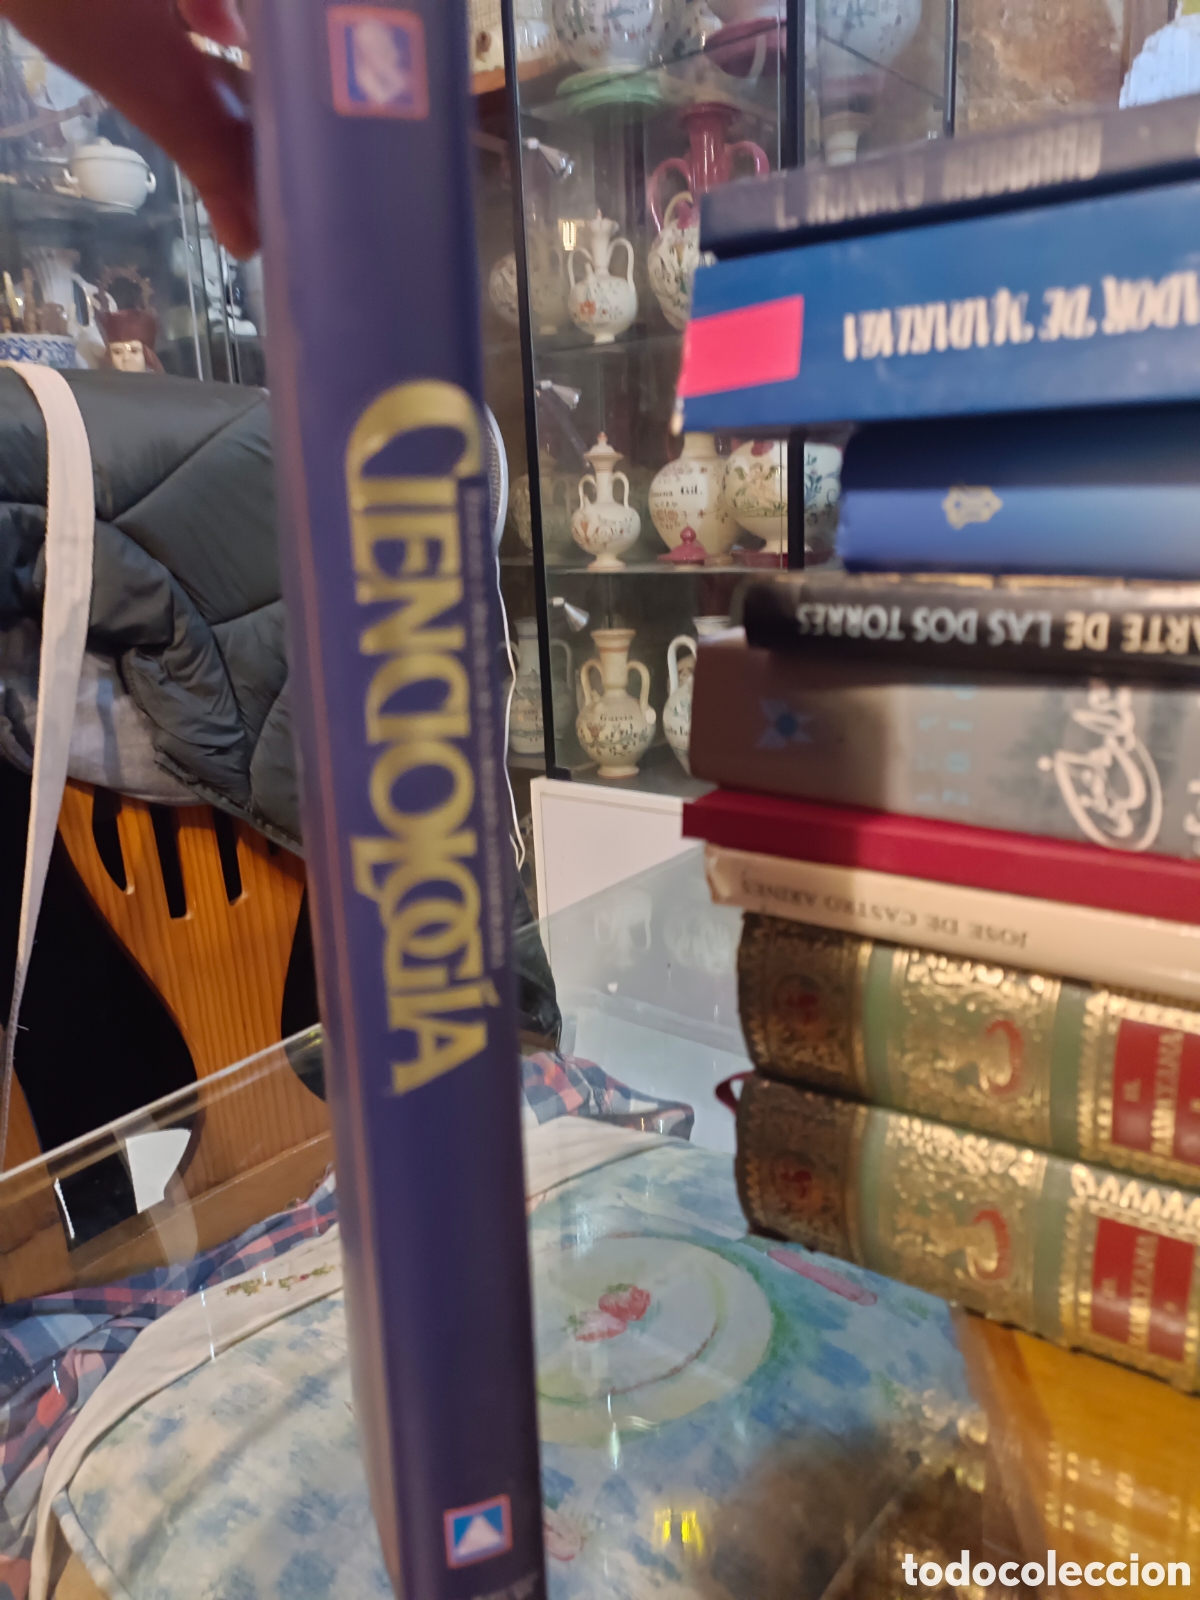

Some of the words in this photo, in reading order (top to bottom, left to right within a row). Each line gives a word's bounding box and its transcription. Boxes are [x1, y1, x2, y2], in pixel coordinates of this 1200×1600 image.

[796, 603, 905, 641] TORRES
[910, 606, 978, 644] DOS
[987, 608, 1052, 648] LAS
[1065, 610, 1111, 650] DE
[345, 378, 499, 1096] CIENCIOLOGÍA
[923, 914, 958, 936] DE
